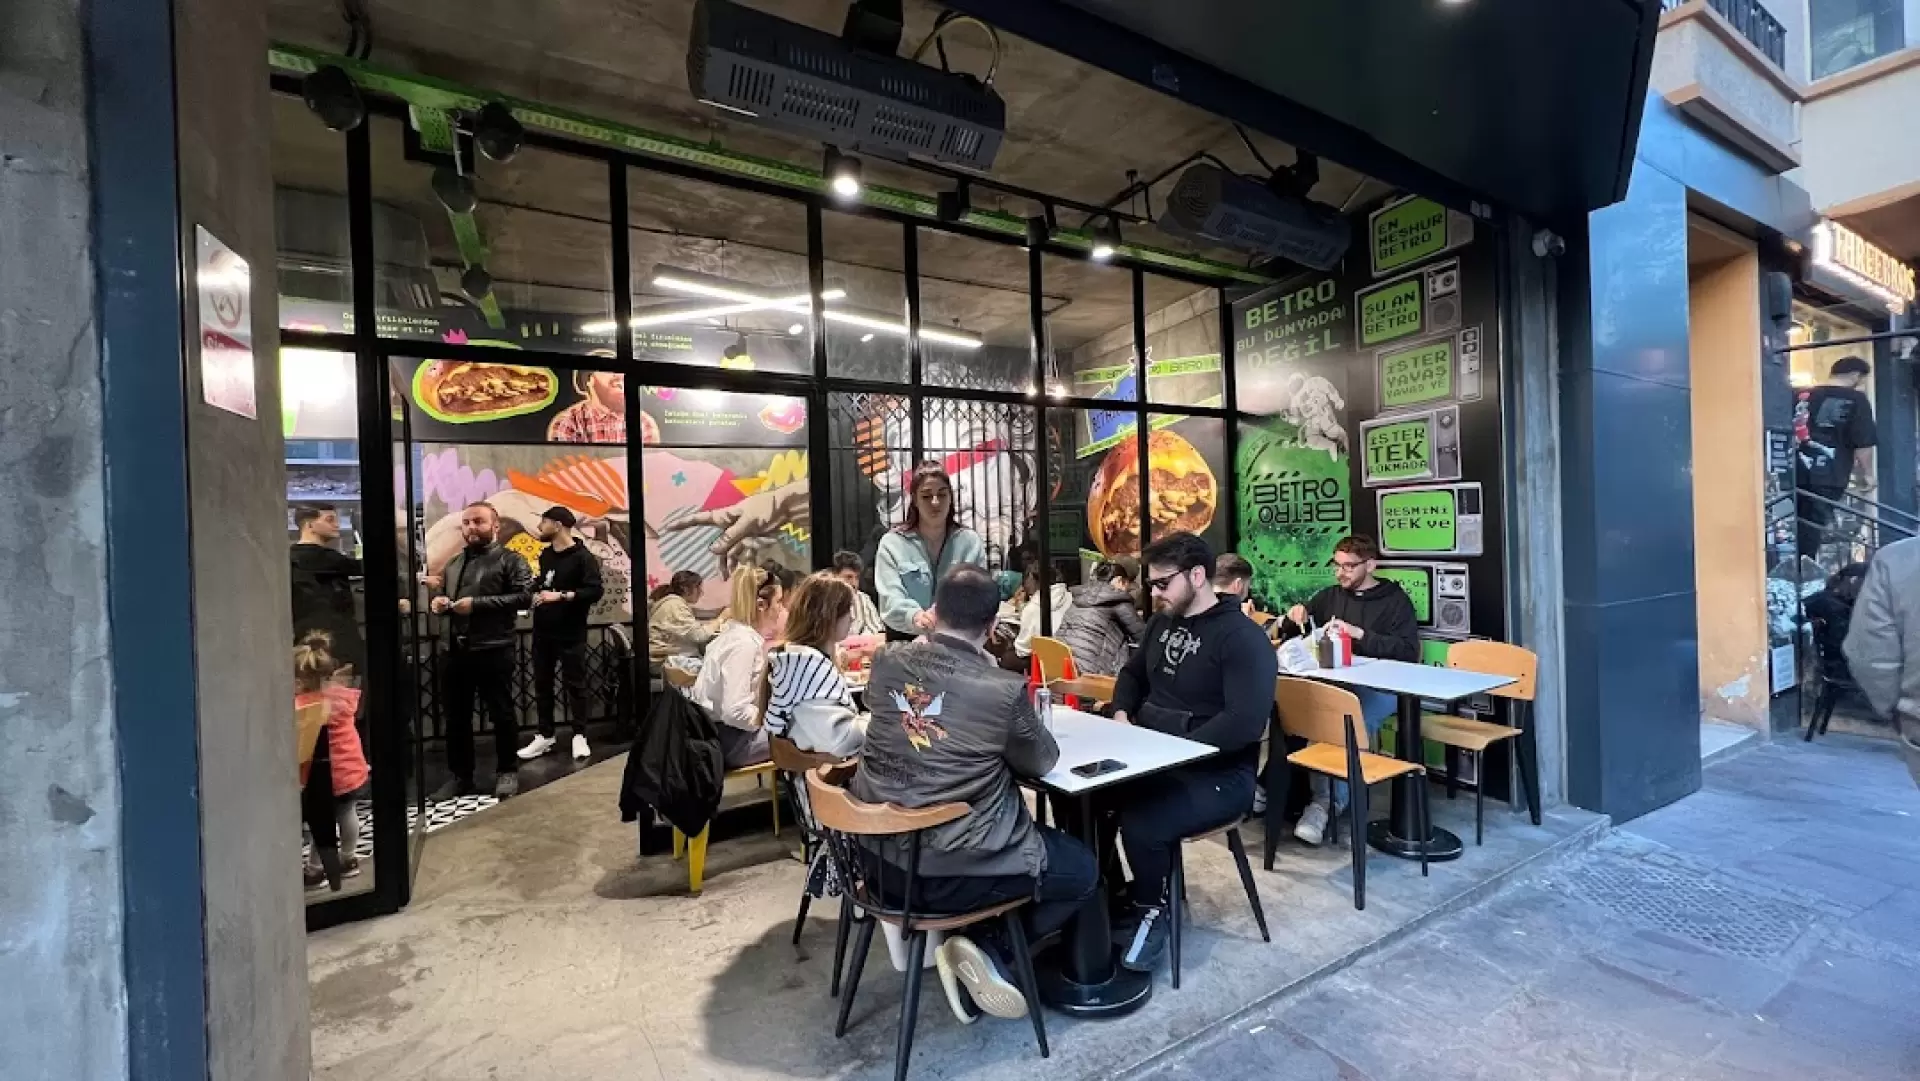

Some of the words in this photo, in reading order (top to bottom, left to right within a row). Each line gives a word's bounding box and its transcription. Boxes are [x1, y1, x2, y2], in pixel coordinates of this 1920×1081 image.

[1379, 217, 1398, 235] EN
[1379, 230, 1432, 260] BETRO
[1245, 279, 1336, 330] BETRO
[1391, 289, 1416, 309] AN
[1364, 310, 1419, 336] BETRO
[1236, 335, 1255, 353] BU
[1370, 439, 1424, 465] TEK
[1253, 477, 1340, 504] BETRO
[1258, 499, 1345, 524] BETRO
